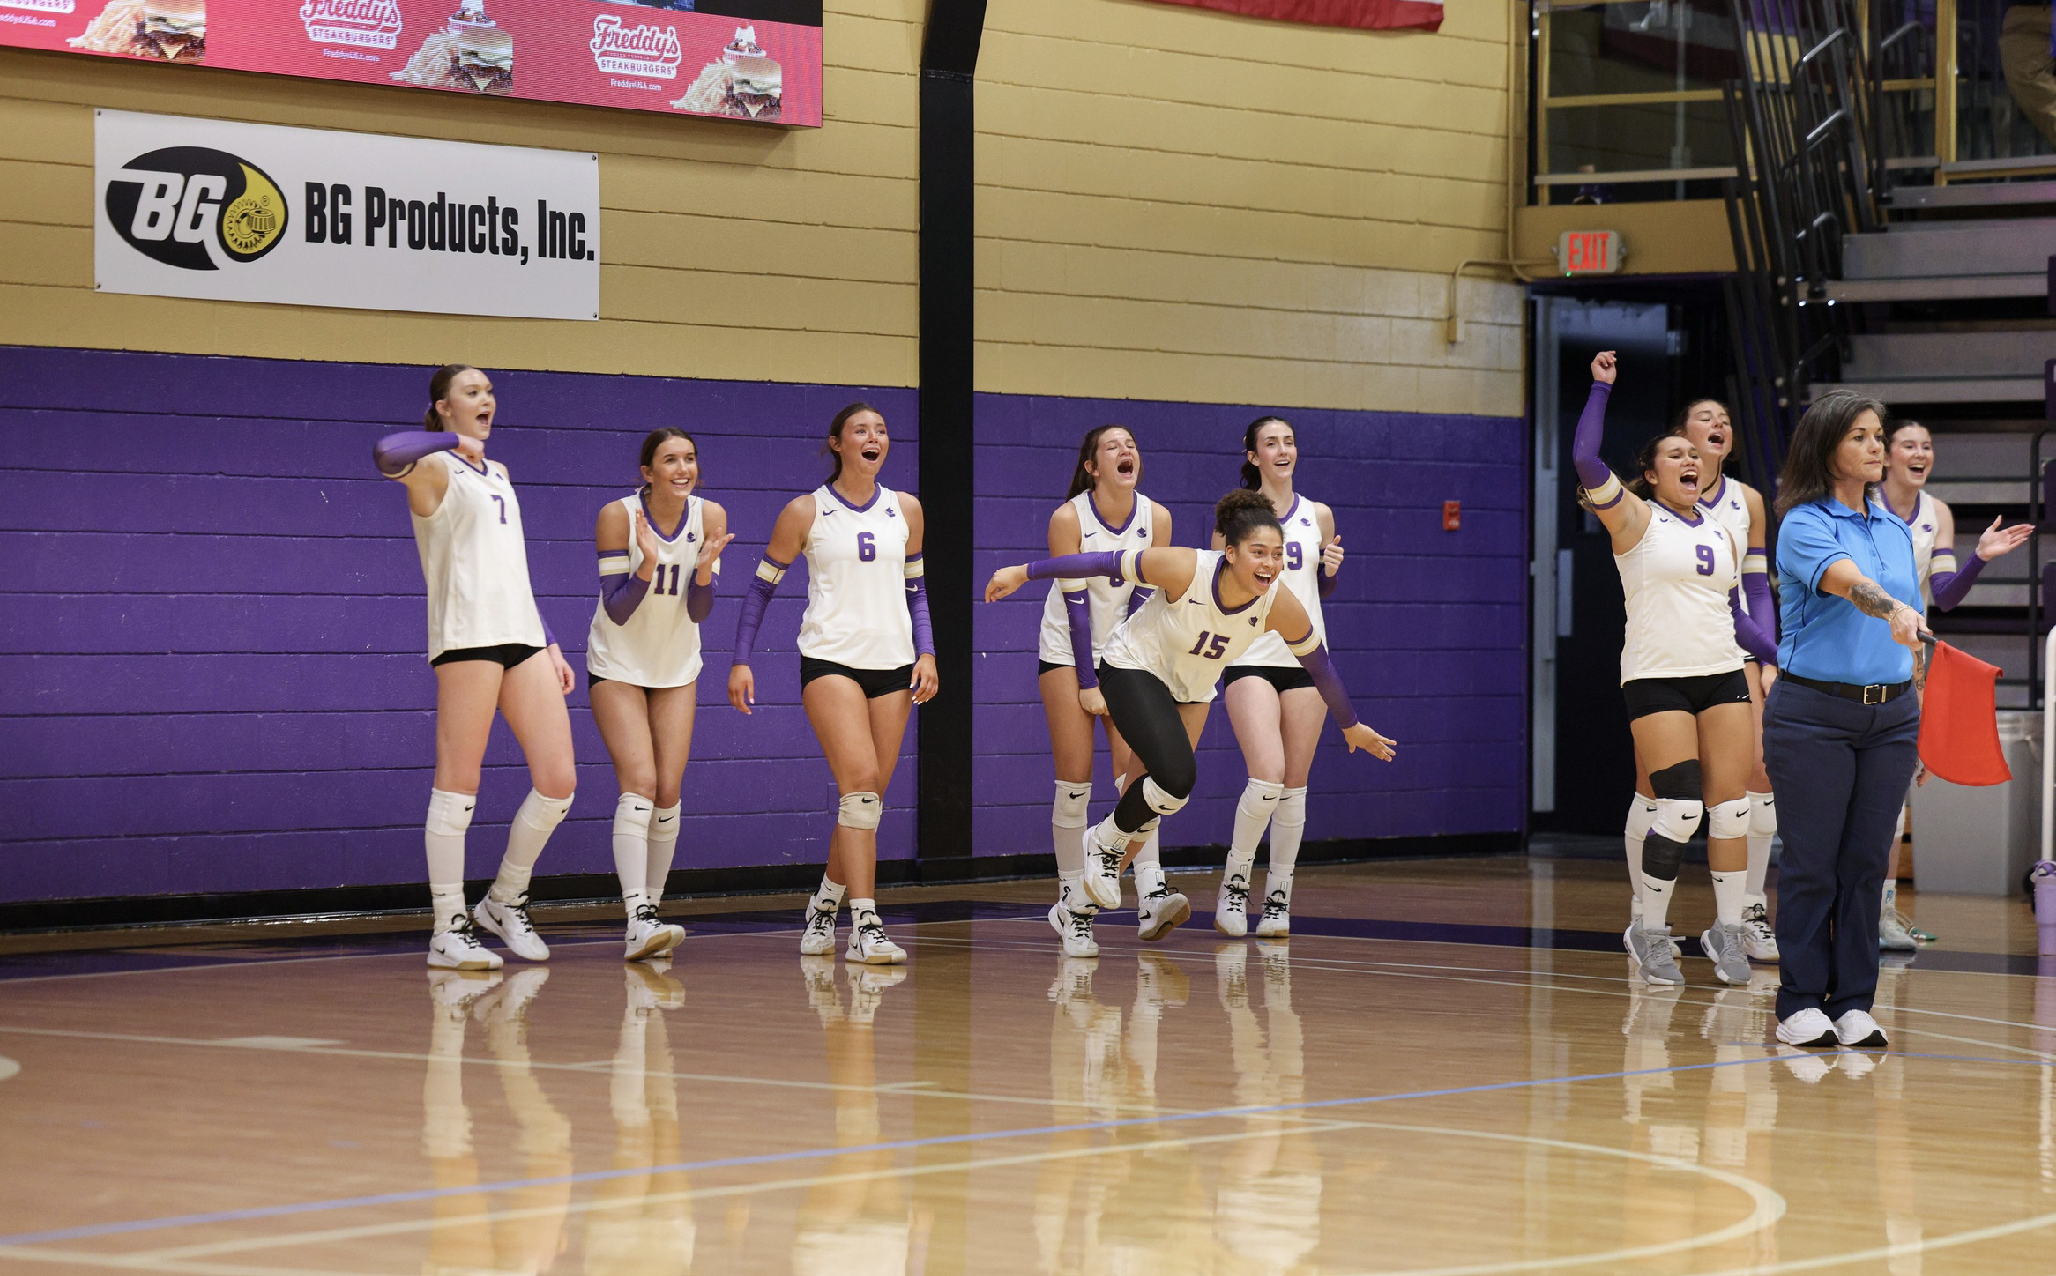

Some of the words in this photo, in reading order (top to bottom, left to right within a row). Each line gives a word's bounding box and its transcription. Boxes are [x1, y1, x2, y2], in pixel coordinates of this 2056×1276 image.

[591, 17, 679, 57] Freddy's
[110, 171, 228, 244] BG
[305, 181, 352, 245] BG
[365, 186, 529, 266] Products,
[538, 199, 595, 261] Inc.
[1568, 232, 1610, 271] EXIT
[490, 494, 507, 525] 7
[857, 531, 876, 562] 6
[1282, 541, 1303, 571] 9
[1695, 544, 1715, 576] 9
[653, 563, 680, 596] 11
[1189, 630, 1231, 660] 15
